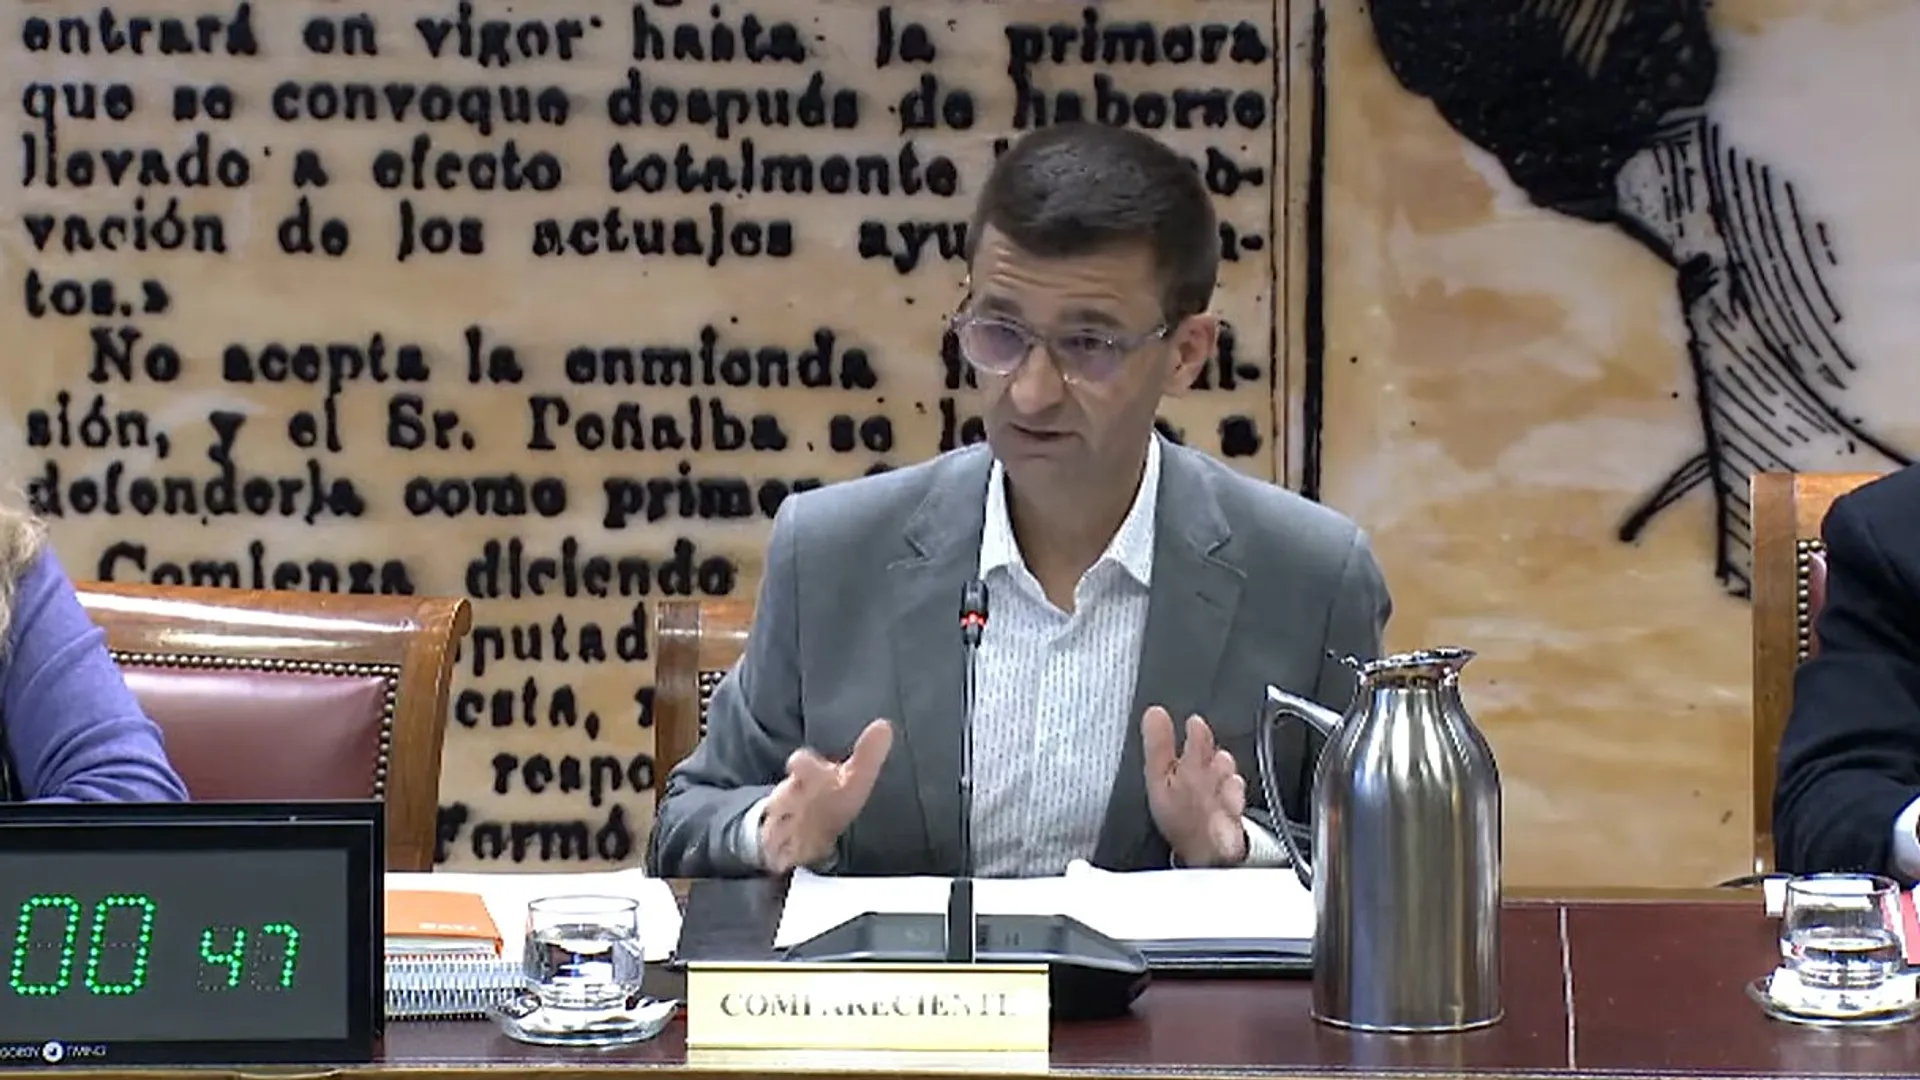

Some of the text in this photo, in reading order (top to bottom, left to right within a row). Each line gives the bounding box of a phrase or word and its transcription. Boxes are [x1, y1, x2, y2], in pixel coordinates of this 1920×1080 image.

[22, 3, 258, 56] entrará
[302, 17, 378, 56] en
[415, 2, 584, 67] vigor
[875, 6, 938, 68] la
[1005, 6, 1267, 78] primera
[22, 83, 135, 135] que
[173, 85, 237, 121] se
[272, 82, 570, 135] convoque
[607, 68, 858, 138] después
[901, 73, 976, 131] de
[22, 133, 958, 194] llevado a efecto totalmente
[23, 197, 227, 254] vación
[278, 197, 349, 256] de
[397, 200, 484, 261] los
[532, 203, 793, 266] actuales
[88, 326, 182, 383] No
[223, 333, 429, 394] acepta
[465, 326, 524, 384] la
[565, 326, 877, 389] enmienda
[27, 391, 170, 458] sión,
[209, 411, 246, 464] y
[288, 393, 341, 451] el
[387, 393, 474, 451] Sr.
[527, 395, 787, 451] Peñalba
[829, 415, 894, 452] se
[404, 475, 568, 516] como
[465, 537, 737, 599] diciendo
[10, 895, 299, 996] 00 47
